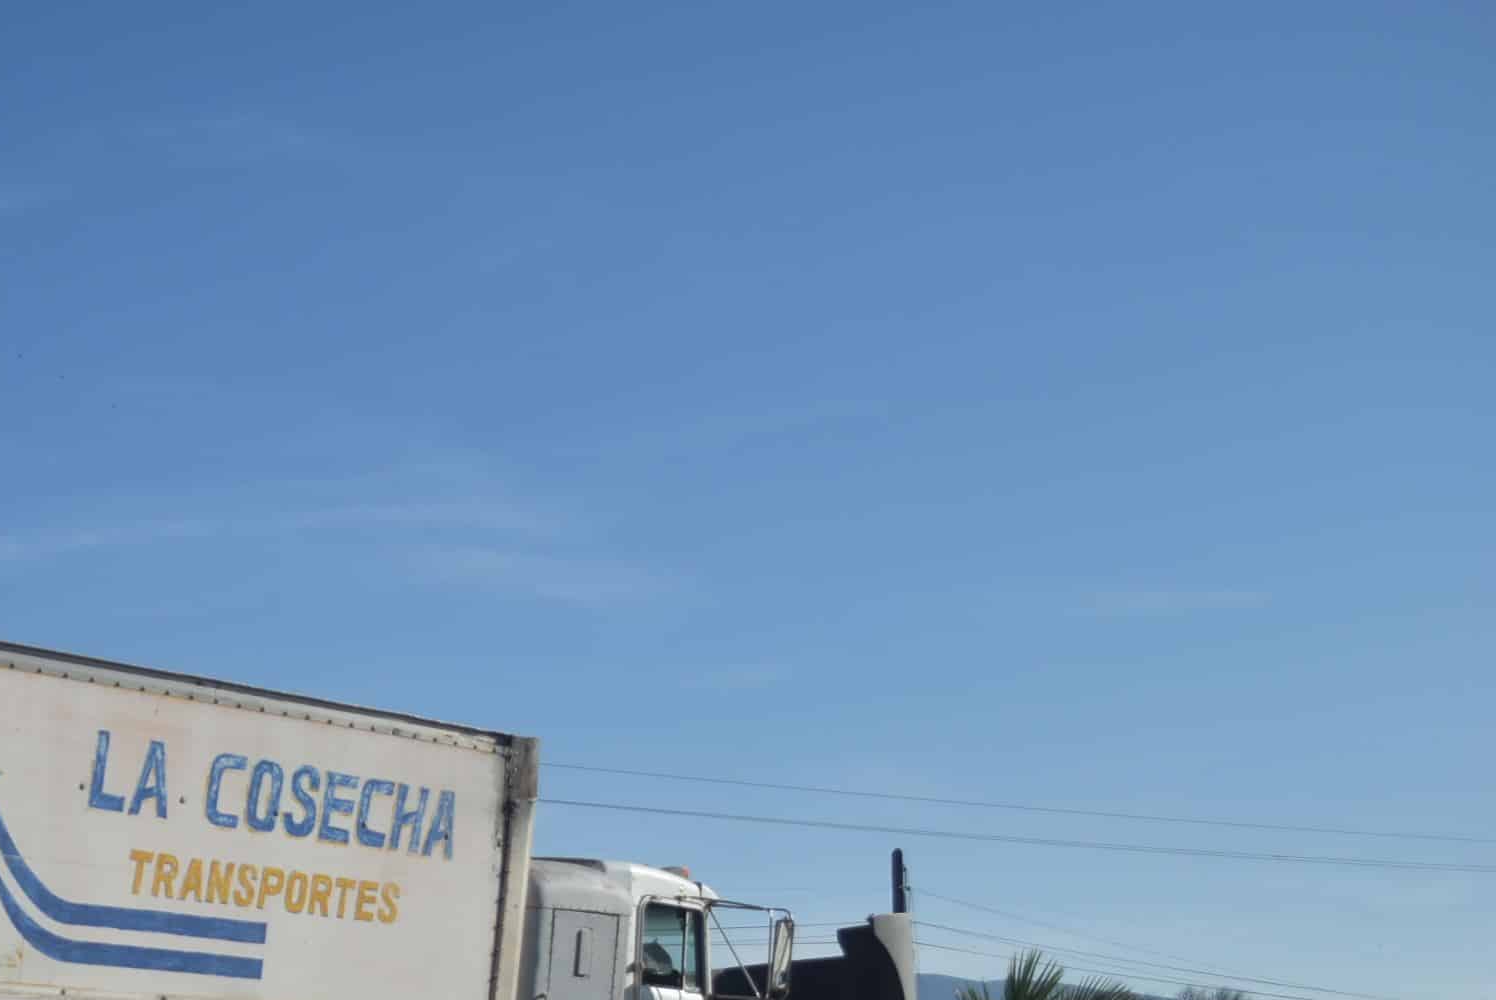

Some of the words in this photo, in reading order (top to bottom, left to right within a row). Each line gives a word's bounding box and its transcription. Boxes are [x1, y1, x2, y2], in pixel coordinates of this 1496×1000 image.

[88, 730, 168, 818] LA
[206, 753, 456, 859] COSECHA
[129, 849, 401, 924] TRANSPORTES
